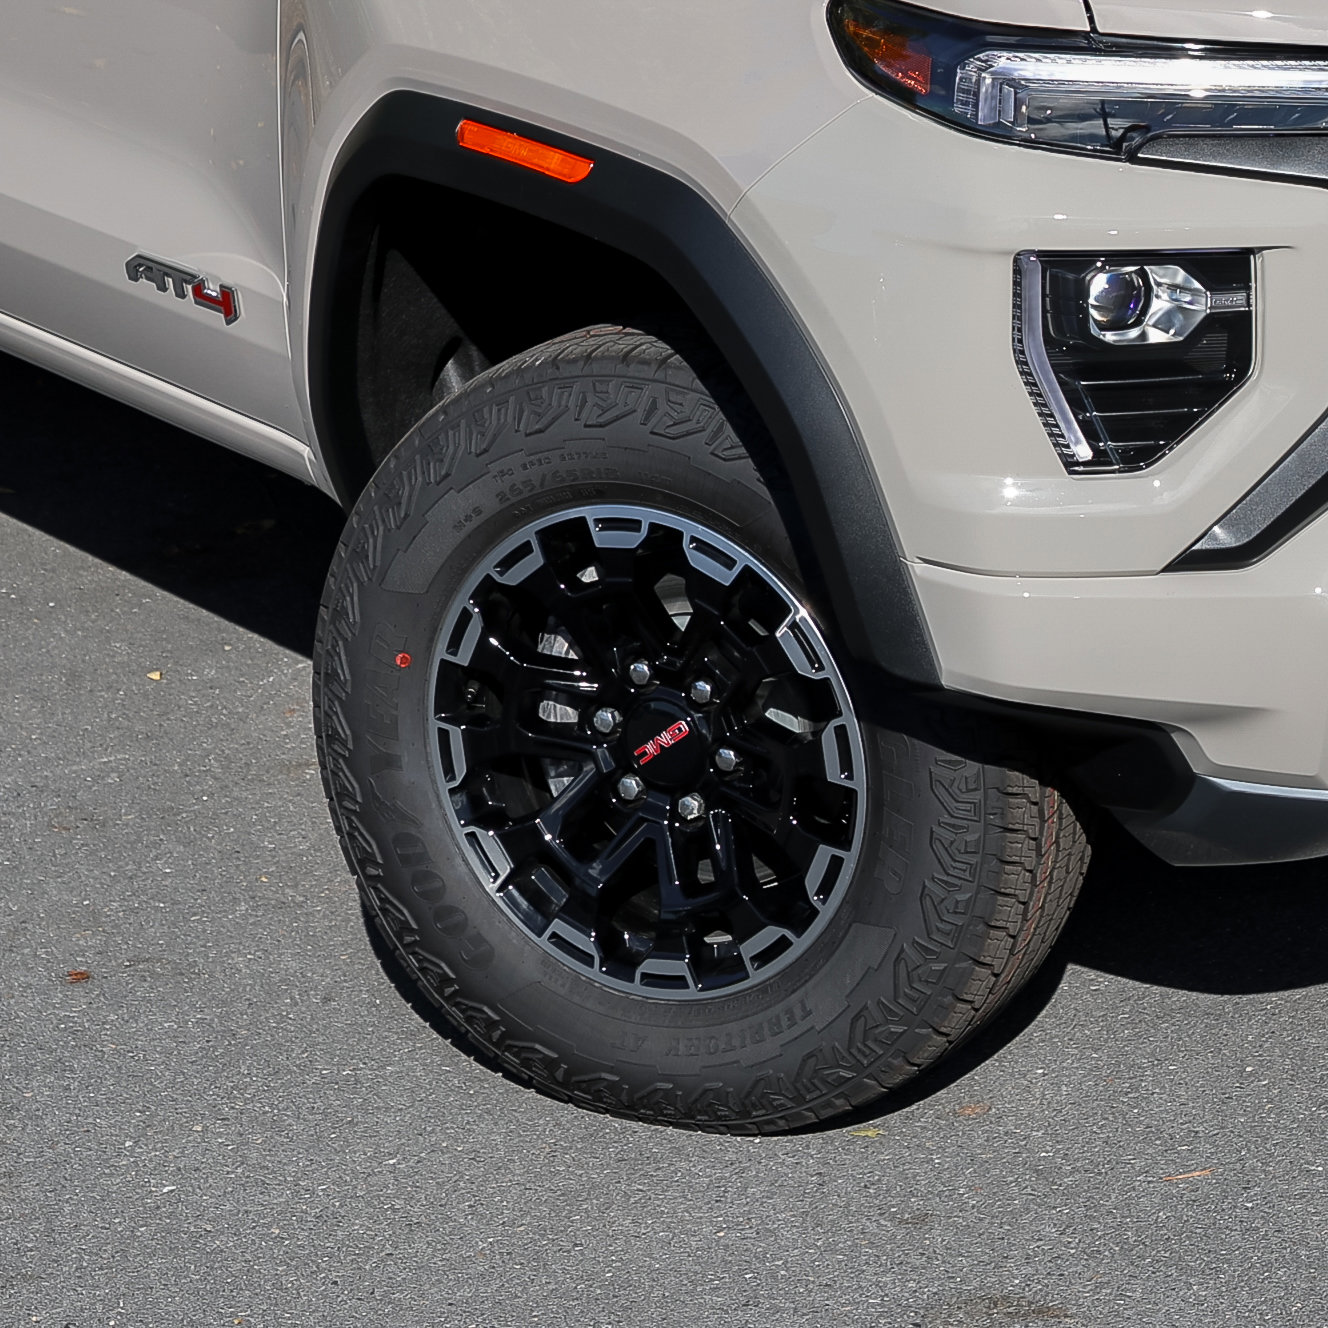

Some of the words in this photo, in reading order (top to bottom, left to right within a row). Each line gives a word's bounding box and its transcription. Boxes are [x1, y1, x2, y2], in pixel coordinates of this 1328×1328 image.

[125, 252, 241, 326] AT4
[633, 720, 690, 766] GMC
[664, 994, 813, 1057] TERRITORY
